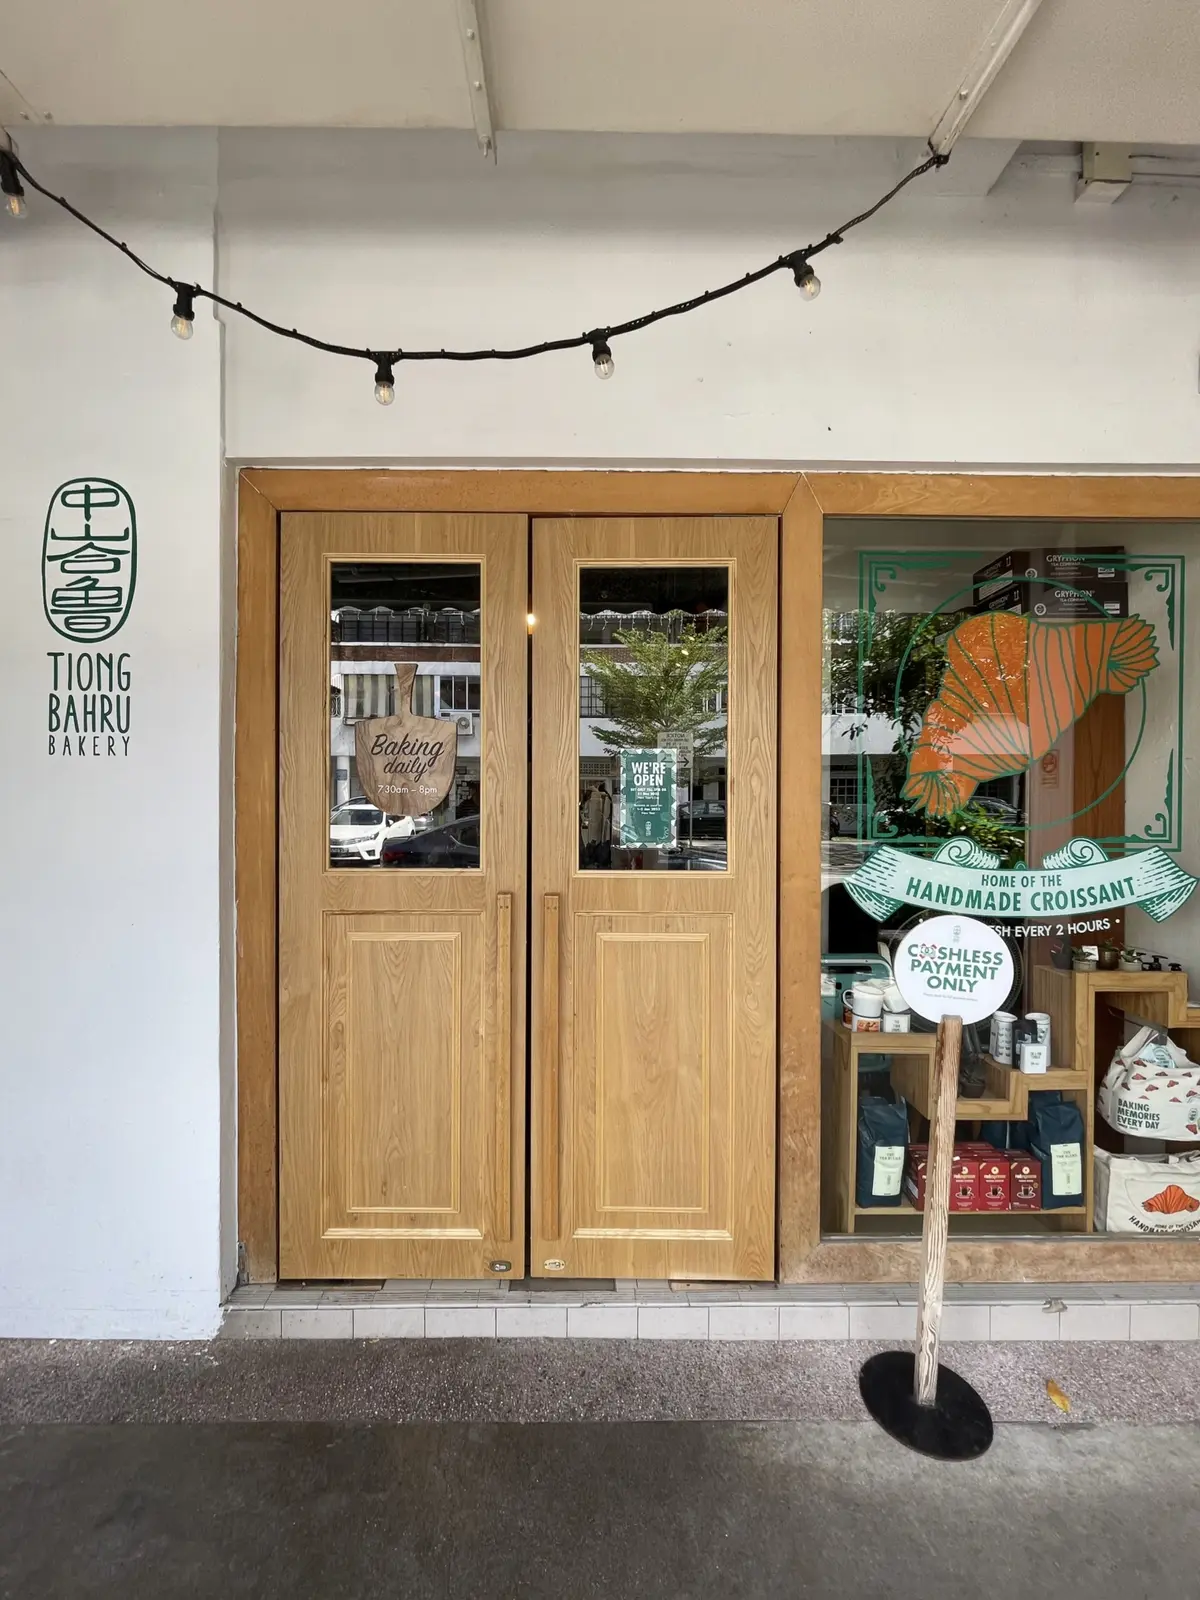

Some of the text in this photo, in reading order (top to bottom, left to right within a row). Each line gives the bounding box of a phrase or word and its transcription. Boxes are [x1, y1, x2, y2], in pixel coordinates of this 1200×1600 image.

[1054, 590, 1092, 598] GRYPHON
[47, 652, 131, 692] TIONG
[48, 693, 131, 733] BAHRU
[48, 735, 130, 757] BAKERY
[371, 733, 444, 767] Baking
[383, 756, 428, 783] daily
[631, 762, 666, 774] WE'RE
[633, 774, 664, 786] OPEN
[419, 785, 438, 796] 8pm
[981, 874, 1062, 887] HOME OF THE
[906, 876, 1135, 911] HANDMADE CROISSANT
[1015, 925, 1051, 938] EVERY
[1056, 924, 1064, 936] 2
[1067, 918, 1111, 936] HOURS
[907, 943, 1004, 966] CSHLESS
[910, 959, 998, 980] PAYMENT
[926, 975, 978, 993] ONLY
[1117, 1107, 1160, 1121] MEMORIES
[1118, 1099, 1150, 1112] BAKING
[1117, 1115, 1144, 1128] EVERY
[1145, 1121, 1160, 1129] DAY
